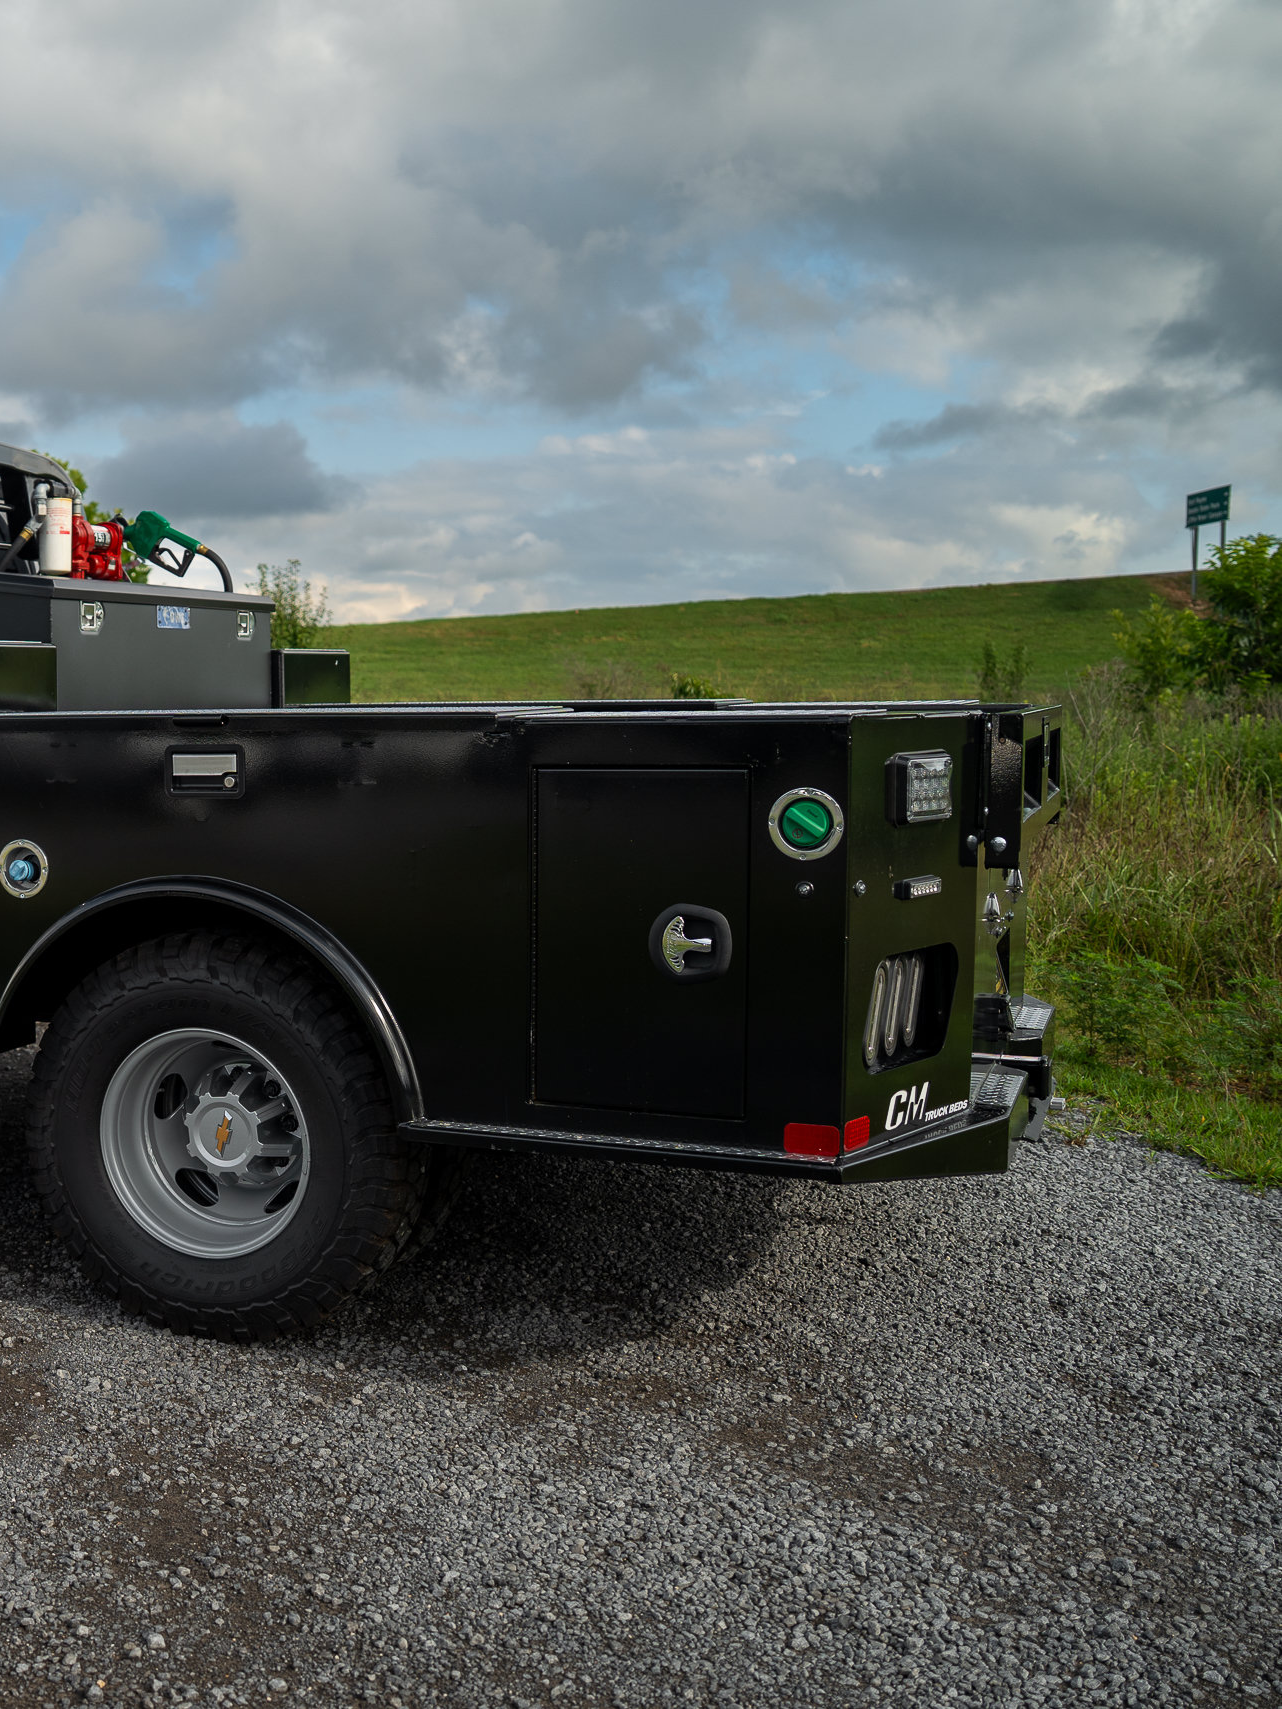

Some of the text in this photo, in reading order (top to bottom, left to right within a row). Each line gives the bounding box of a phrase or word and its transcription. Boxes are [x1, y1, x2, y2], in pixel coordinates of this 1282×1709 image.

[885, 1081, 930, 1131] CM
[924, 1099, 969, 1122] TRUCK BEDS
